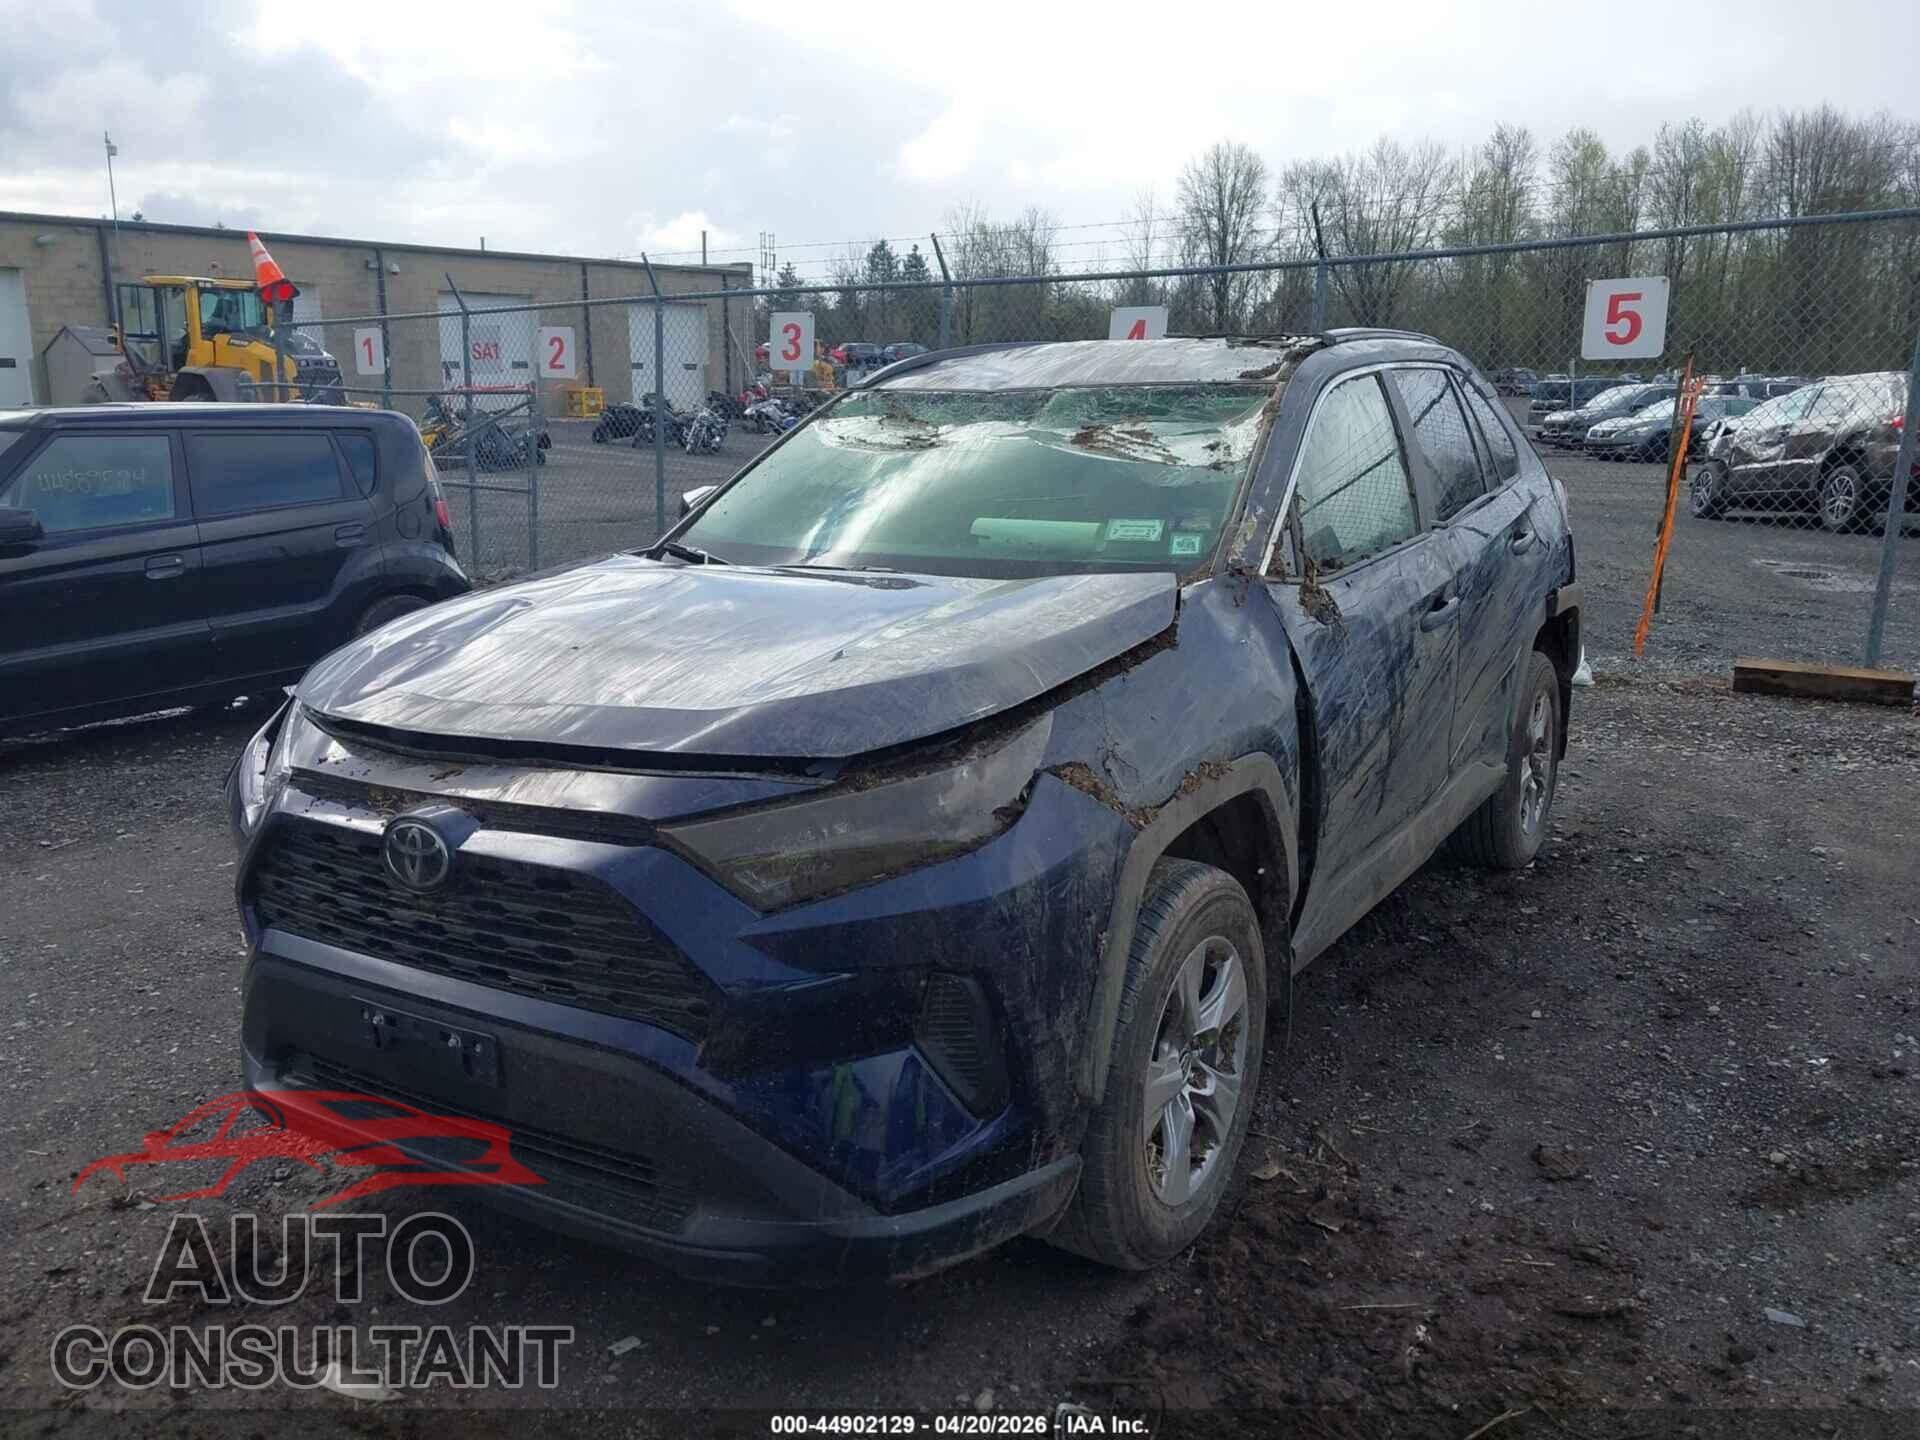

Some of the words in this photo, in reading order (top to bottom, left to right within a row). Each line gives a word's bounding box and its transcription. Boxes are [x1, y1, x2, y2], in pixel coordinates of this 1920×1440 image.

[1604, 292, 1643, 345] 5
[362, 336, 374, 367] 1
[548, 336, 566, 370] 2
[781, 323, 802, 362] 3
